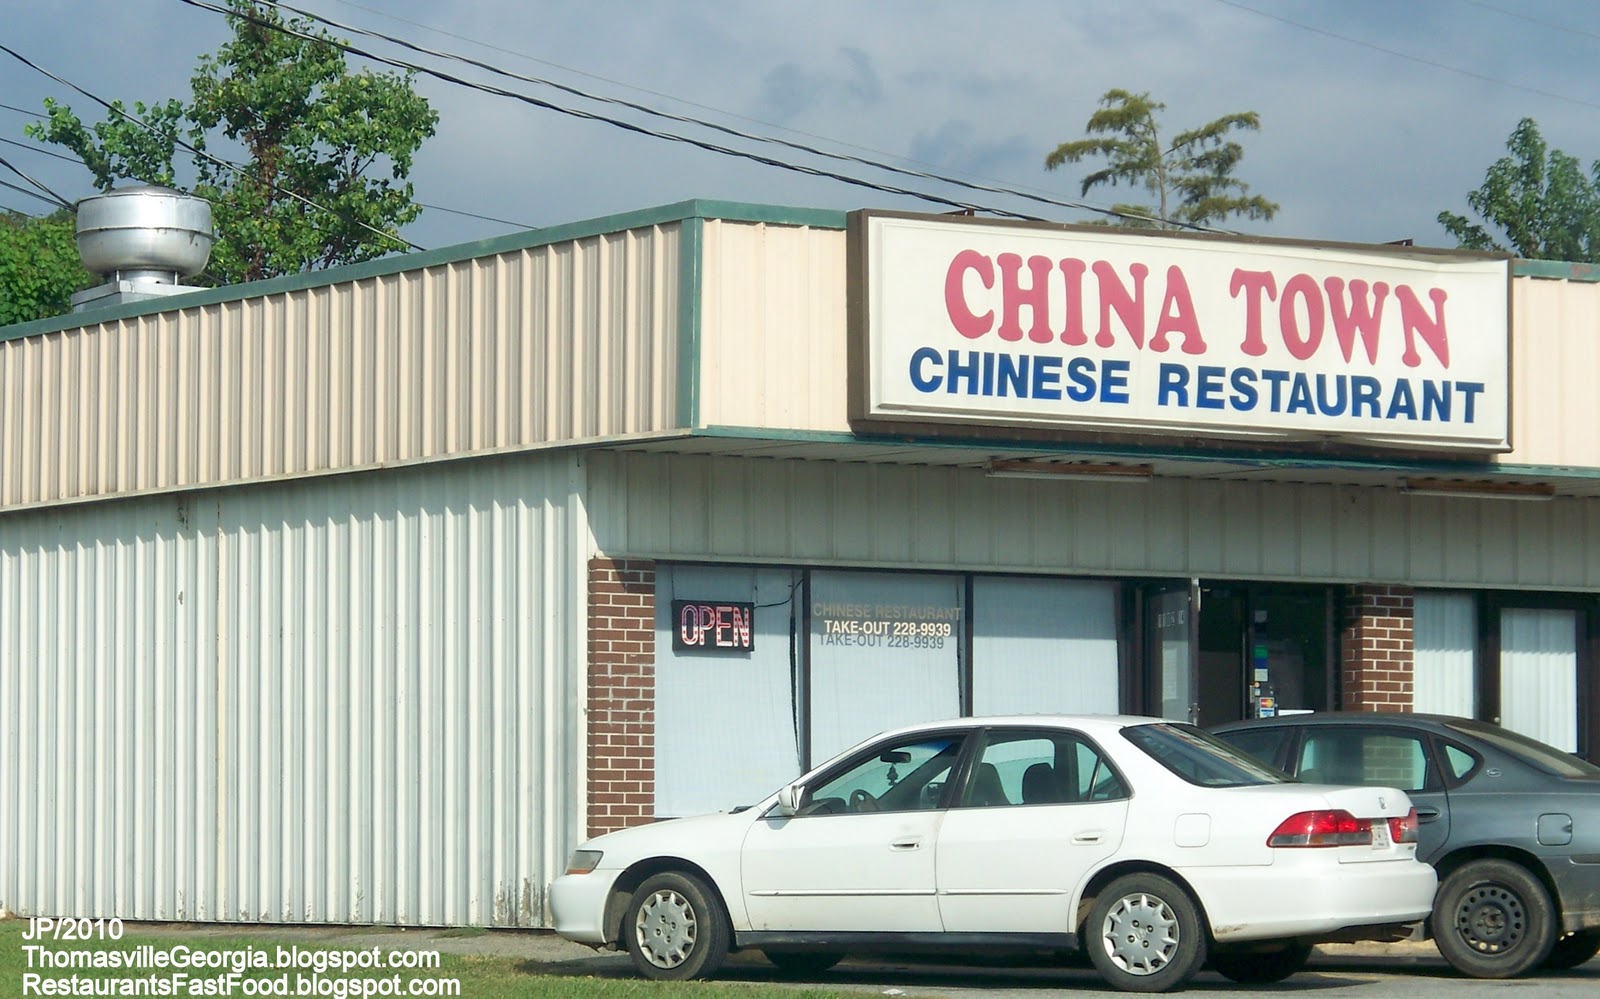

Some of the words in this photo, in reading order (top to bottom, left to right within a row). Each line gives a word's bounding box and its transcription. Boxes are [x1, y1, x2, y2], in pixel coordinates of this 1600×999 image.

[945, 249, 1207, 353] CHINA
[1229, 268, 1449, 369] TOWN
[909, 347, 1130, 404] CHINESE
[1158, 363, 1485, 423] RESTAURANT
[680, 604, 750, 648] OPEN
[813, 603, 871, 617] CHINESE
[876, 605, 961, 620] RESTAURANT
[824, 619, 890, 635] TAKE-OUT
[893, 621, 952, 637] 228-9939
